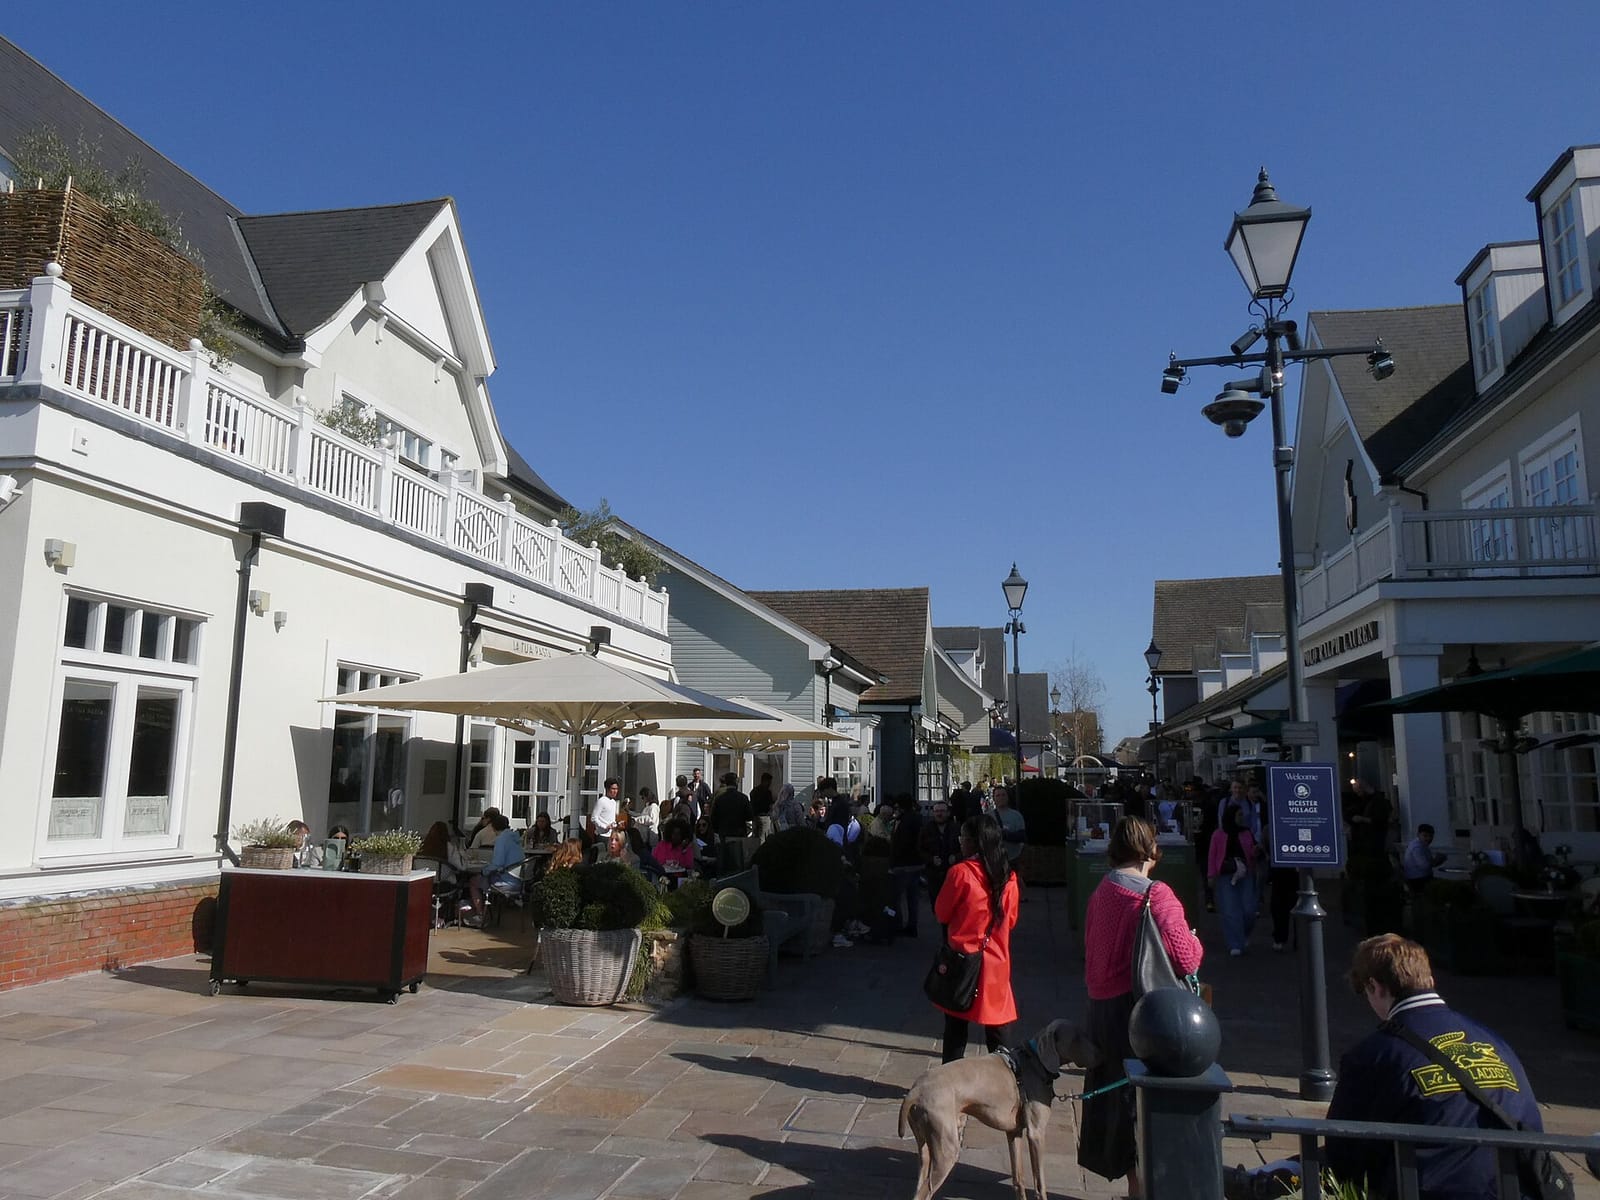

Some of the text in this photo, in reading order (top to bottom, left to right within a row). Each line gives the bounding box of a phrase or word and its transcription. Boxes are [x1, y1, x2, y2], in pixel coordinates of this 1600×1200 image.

[513, 640, 519, 651] LA
[521, 642, 533, 655] TUA
[1285, 772, 1318, 781] Welcome
